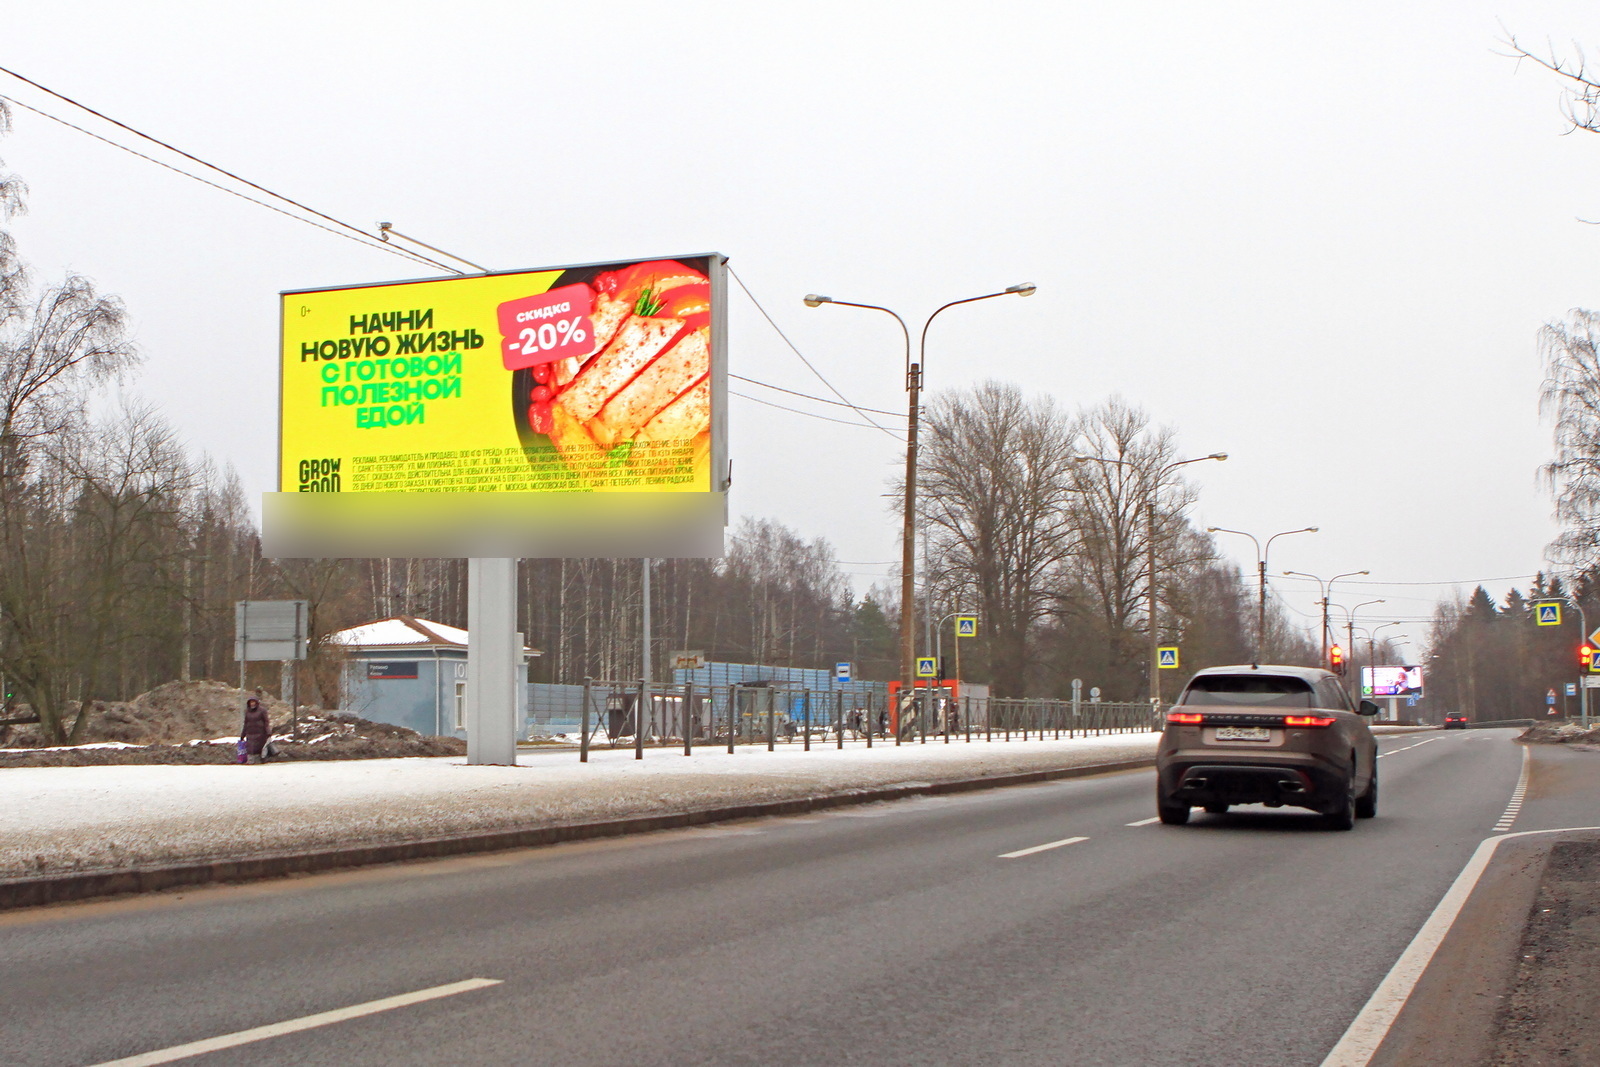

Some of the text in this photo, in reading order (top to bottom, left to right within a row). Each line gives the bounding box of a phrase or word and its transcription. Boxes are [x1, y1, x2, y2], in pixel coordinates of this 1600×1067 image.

[301, 305, 311, 317] 0+
[350, 308, 433, 335] НАЧНИ
[516, 301, 571, 323] скидка
[301, 329, 484, 362] НОВУЮ ЖИЗНЬ
[508, 316, 586, 356] -20%
[321, 351, 462, 384] С ГОТОВОЙ
[321, 375, 462, 407] ПОЛЕЗНОЙ
[356, 402, 424, 430] ЕДОЙ
[299, 458, 341, 484] GROW
